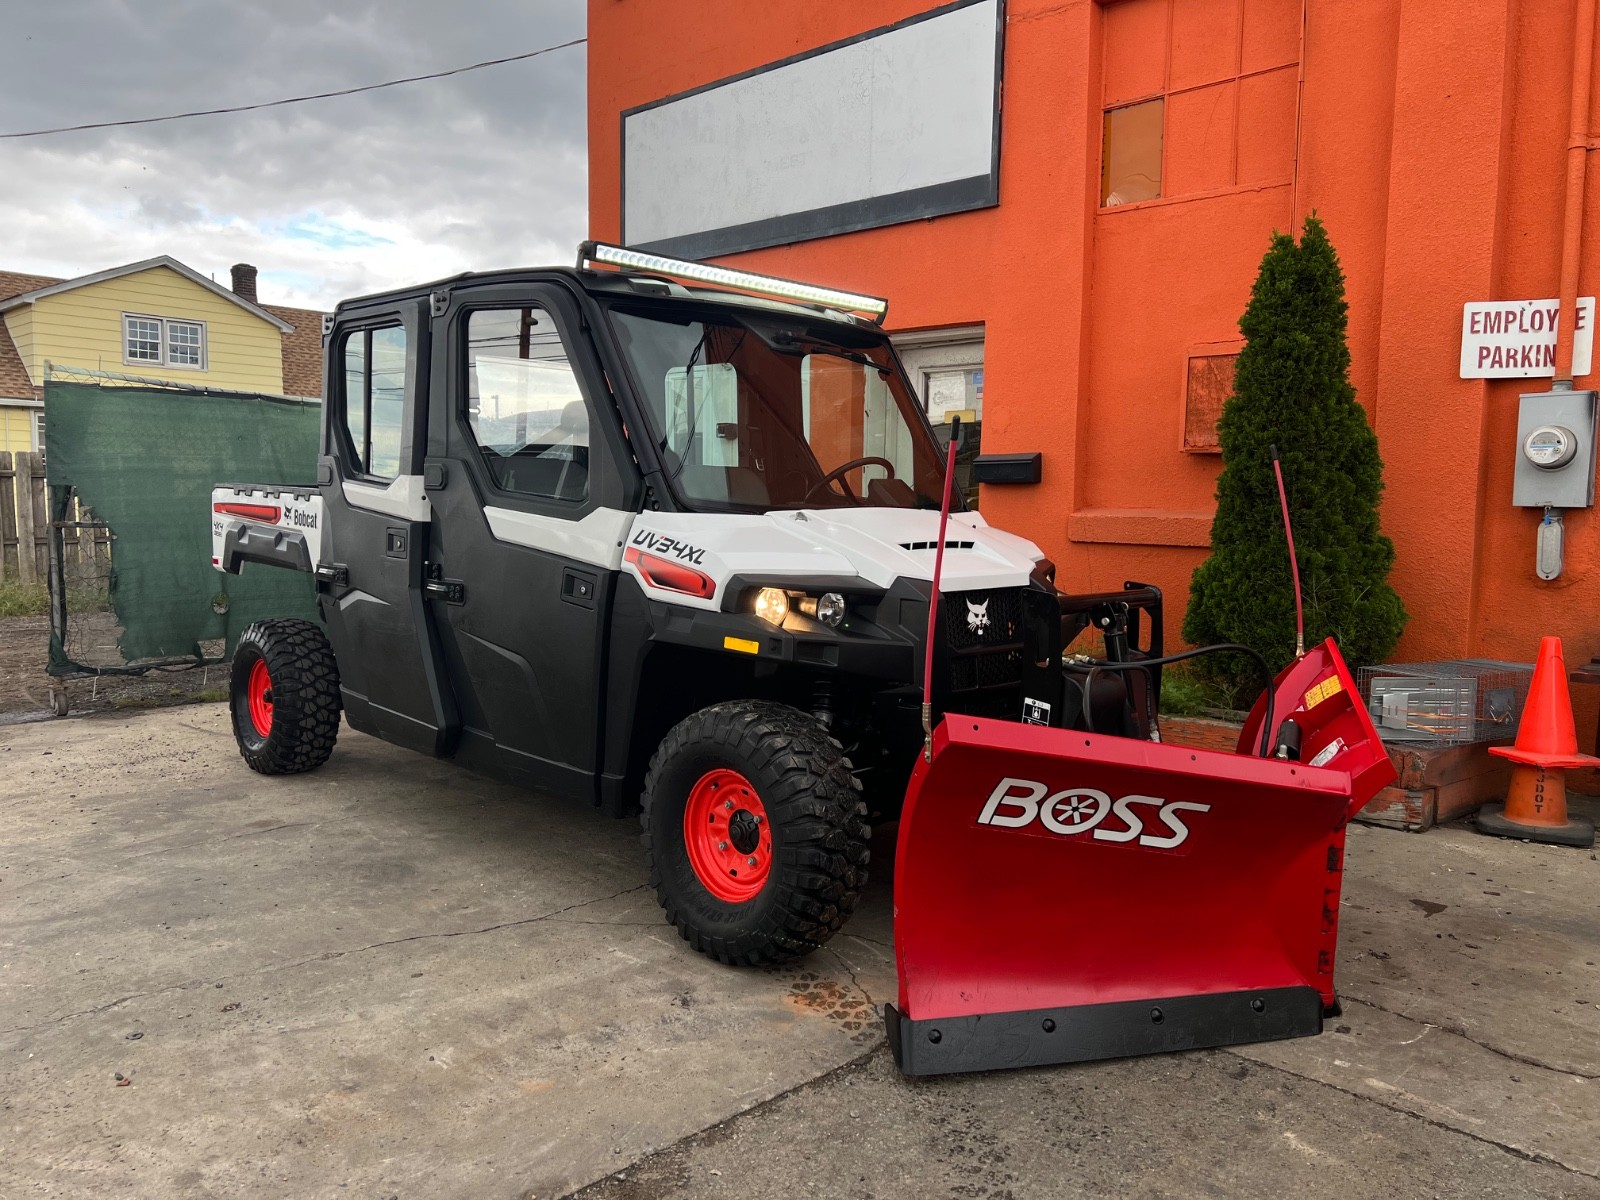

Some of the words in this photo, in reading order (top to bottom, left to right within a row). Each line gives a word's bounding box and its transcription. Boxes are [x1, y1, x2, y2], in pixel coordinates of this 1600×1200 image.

[1469, 306, 1587, 335] EMPLOYE
[1477, 343, 1557, 369] PARKIN
[294, 508, 318, 529] Bobcat
[632, 529, 707, 565] UV34XL
[976, 776, 1212, 849] BOSS
